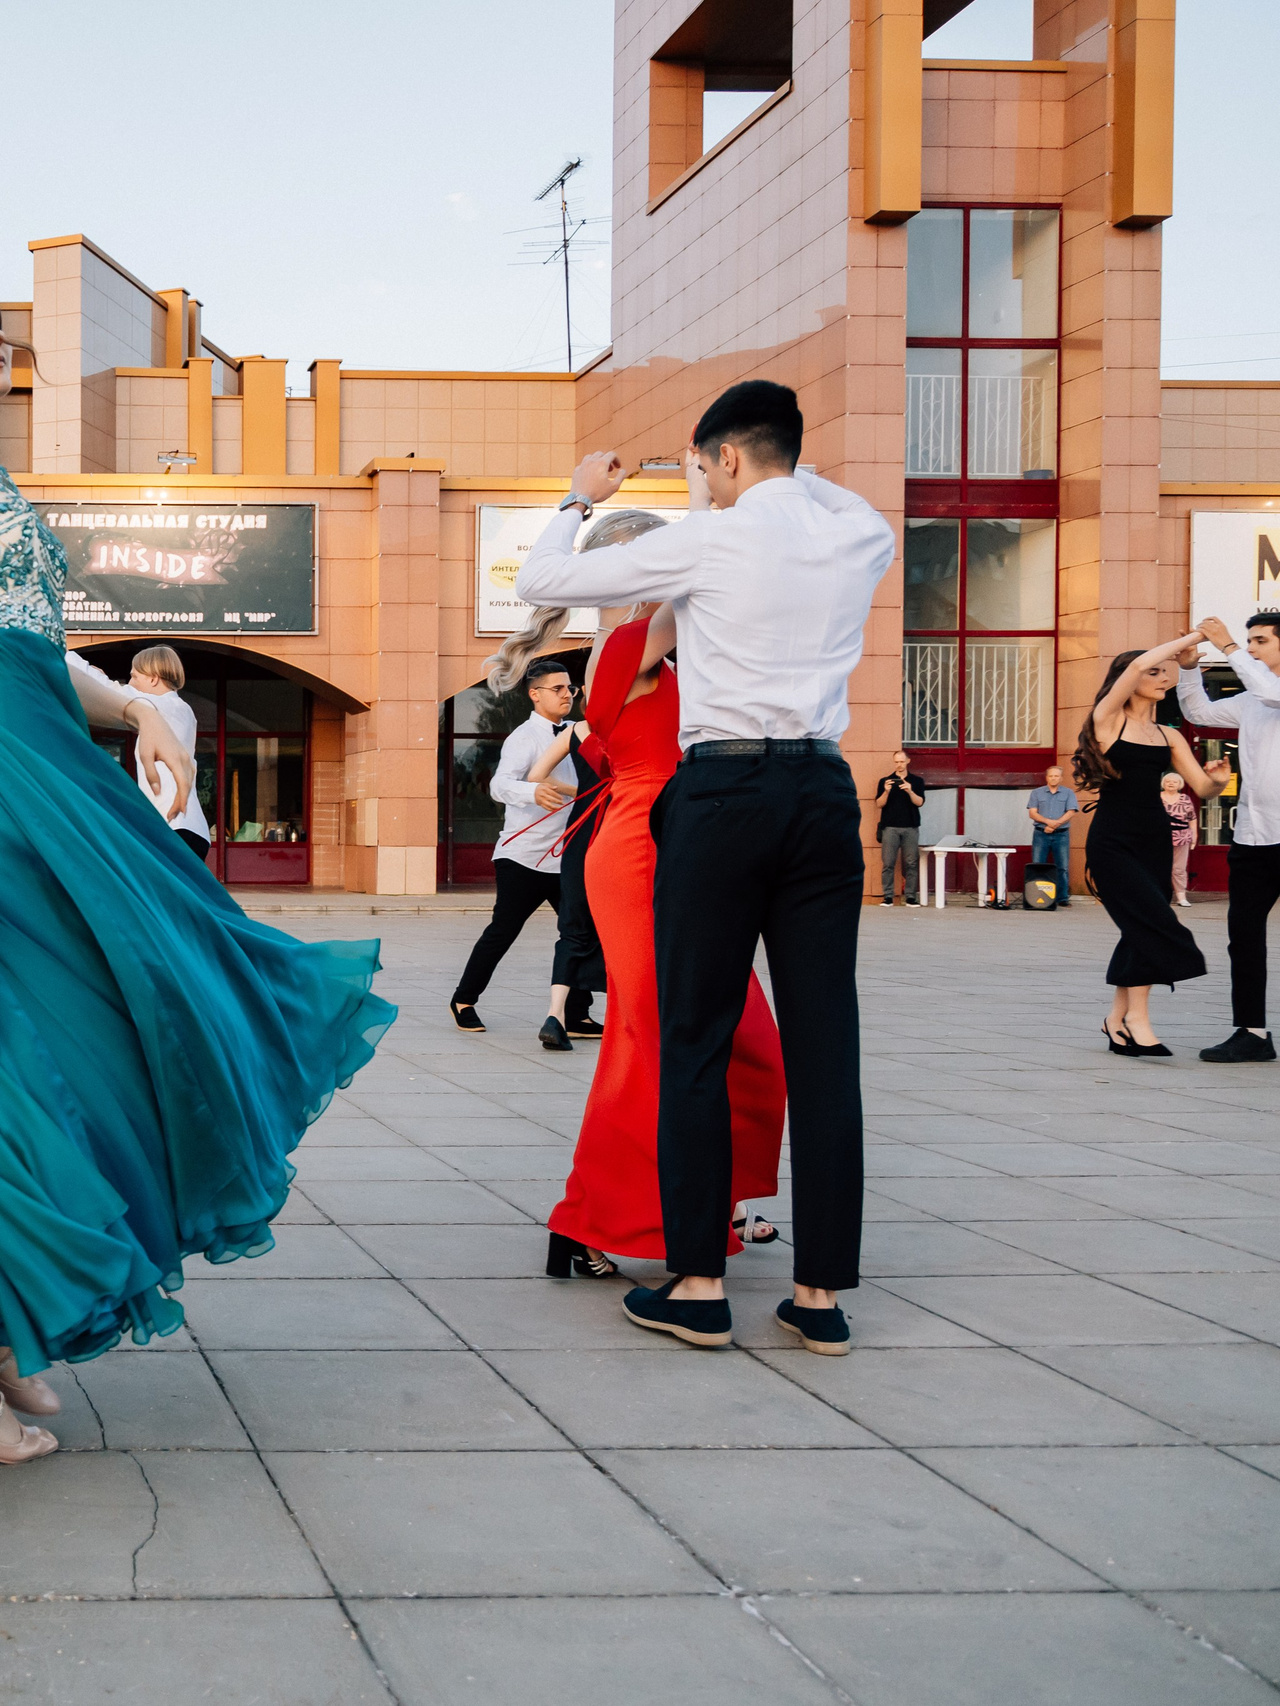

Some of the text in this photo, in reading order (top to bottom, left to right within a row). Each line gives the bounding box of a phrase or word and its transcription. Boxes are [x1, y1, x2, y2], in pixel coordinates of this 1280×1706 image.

[47, 513, 268, 531] ТАНЦЕВАЛЬНАЯ СТУДИЯ
[98, 545, 207, 580] INSIDE
[123, 612, 204, 622] ХОРЕОГРАФИЯ
